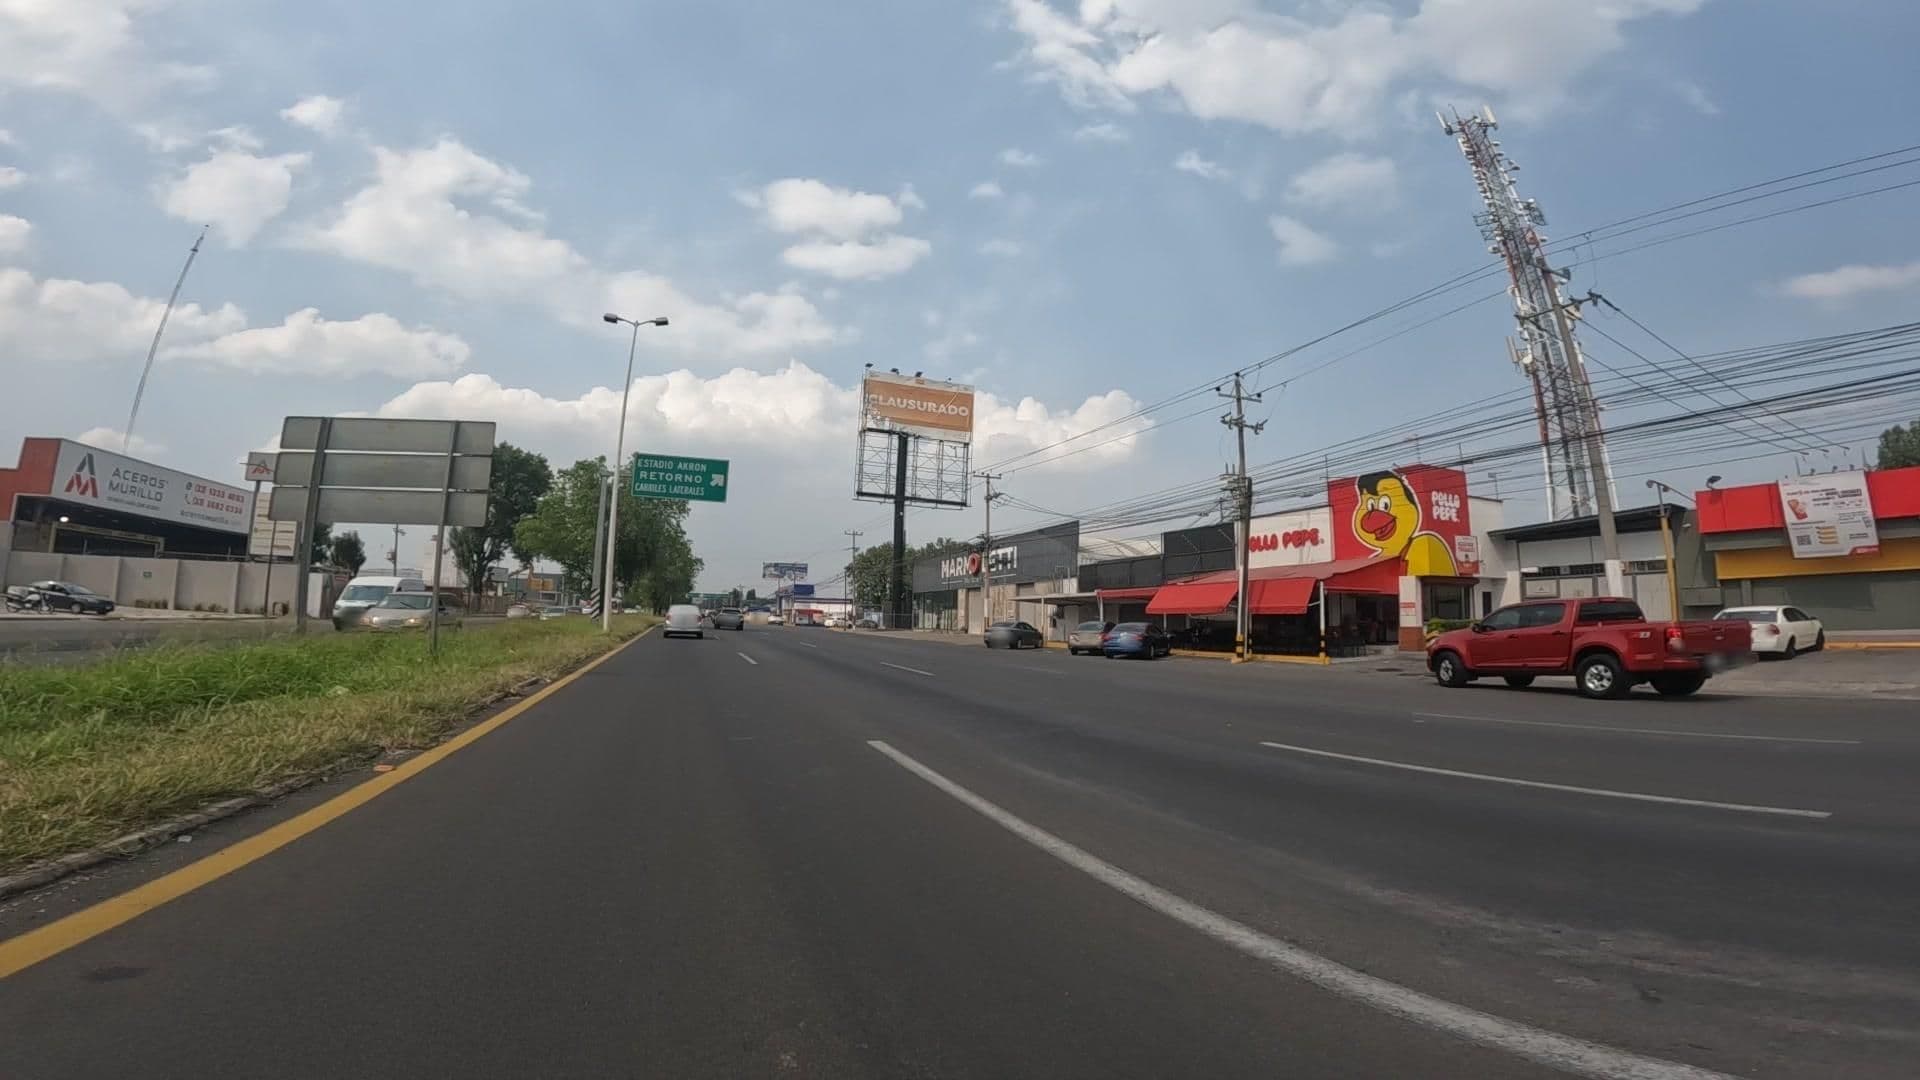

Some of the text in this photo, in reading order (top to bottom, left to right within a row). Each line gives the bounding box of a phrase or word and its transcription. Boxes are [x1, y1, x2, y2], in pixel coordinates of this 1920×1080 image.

[869, 393, 969, 417] CLAUSURADO
[638, 459, 706, 472] ESTADIO AKRON
[640, 471, 702, 483] RETORNO
[108, 480, 163, 502] MURILLO
[635, 483, 704, 495] CARRILES LATERALES
[1431, 490, 1460, 508] POLLO
[1432, 506, 1457, 522] PEPE
[1248, 527, 1320, 553] OLLO PEPE
